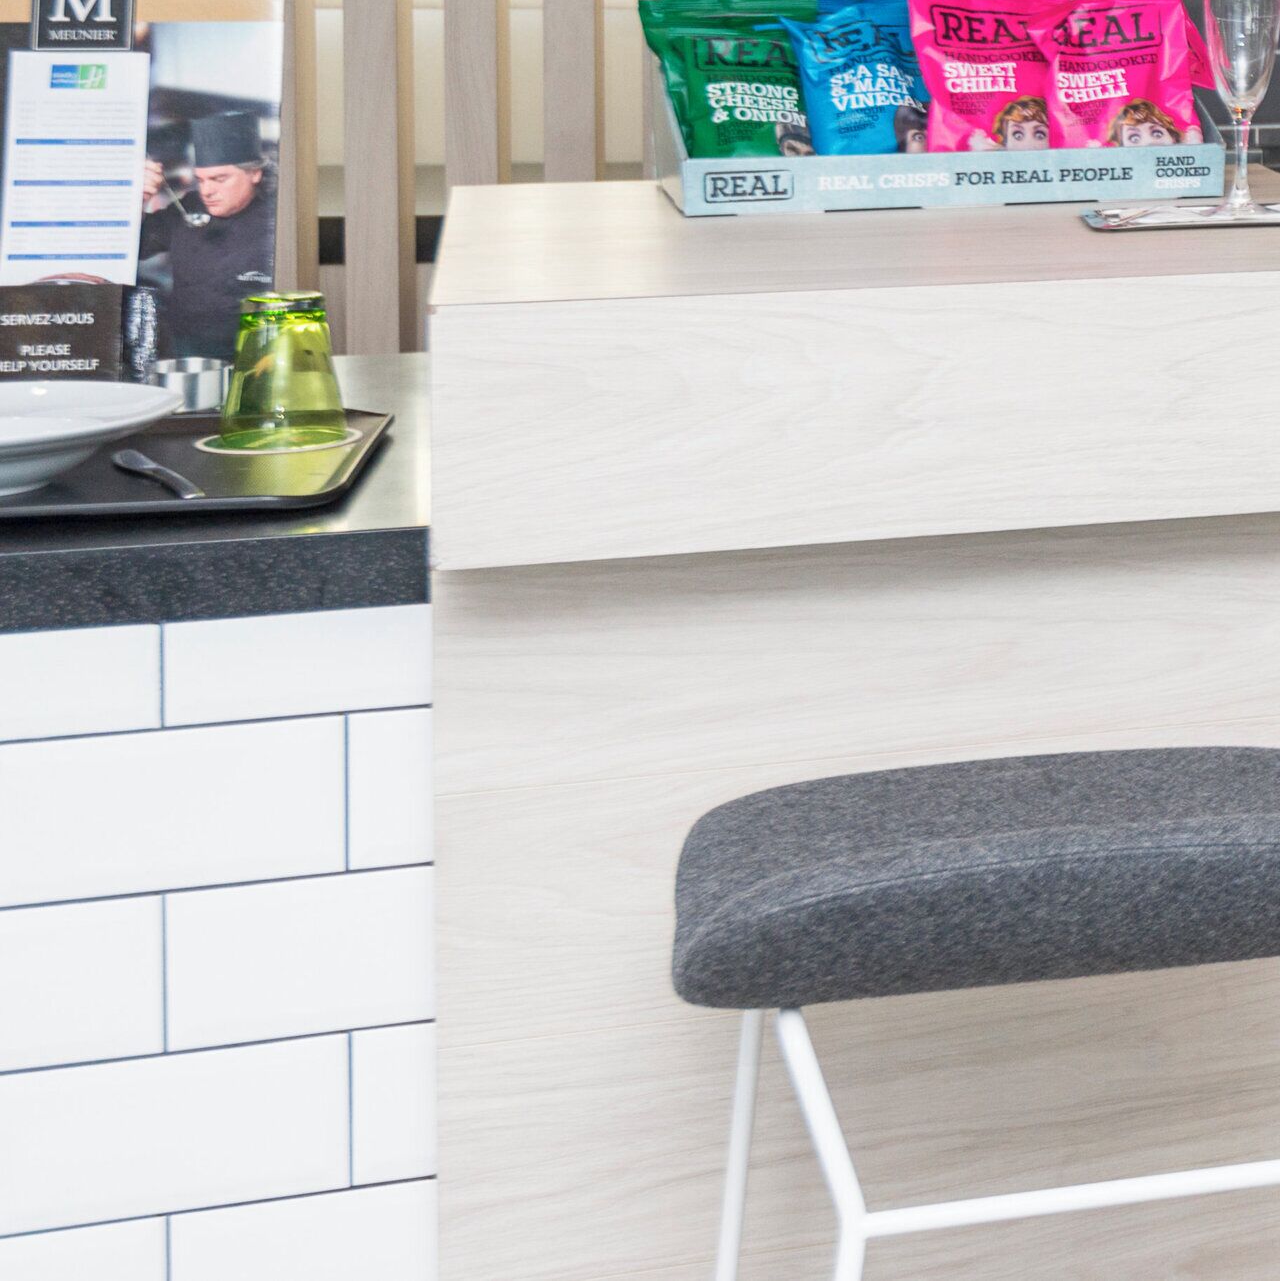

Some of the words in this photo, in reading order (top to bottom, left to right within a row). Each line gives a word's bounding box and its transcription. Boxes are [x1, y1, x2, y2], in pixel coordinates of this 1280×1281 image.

[706, 37, 791, 67] REA
[830, 64, 873, 87] SEA
[876, 63, 914, 88] SALT
[944, 61, 1017, 78] SWEET
[1057, 68, 1126, 88] SWEET
[706, 81, 799, 100] STRONG
[854, 77, 909, 95] MALT
[946, 77, 1018, 93] CHILLI
[1059, 82, 1130, 103] CHILLI
[709, 94, 799, 112] CHEESE
[712, 108, 730, 123] &
[733, 107, 807, 127] ONION
[1155, 156, 1196, 167] HAND
[818, 175, 874, 191] REAL
[879, 173, 950, 188] CRISPS
[955, 172, 996, 186] FOR
[1001, 169, 1055, 184] REAL
[1059, 167, 1133, 182] PEOPLE
[1155, 166, 1211, 178] COOKED
[711, 174, 788, 198] REAL
[1154, 178, 1201, 190] CRISPS
[0, 313, 95, 326] SERVEZ-VOUS
[20, 343, 71, 357] PLEASE
[30, 359, 100, 372] YOURSELF
